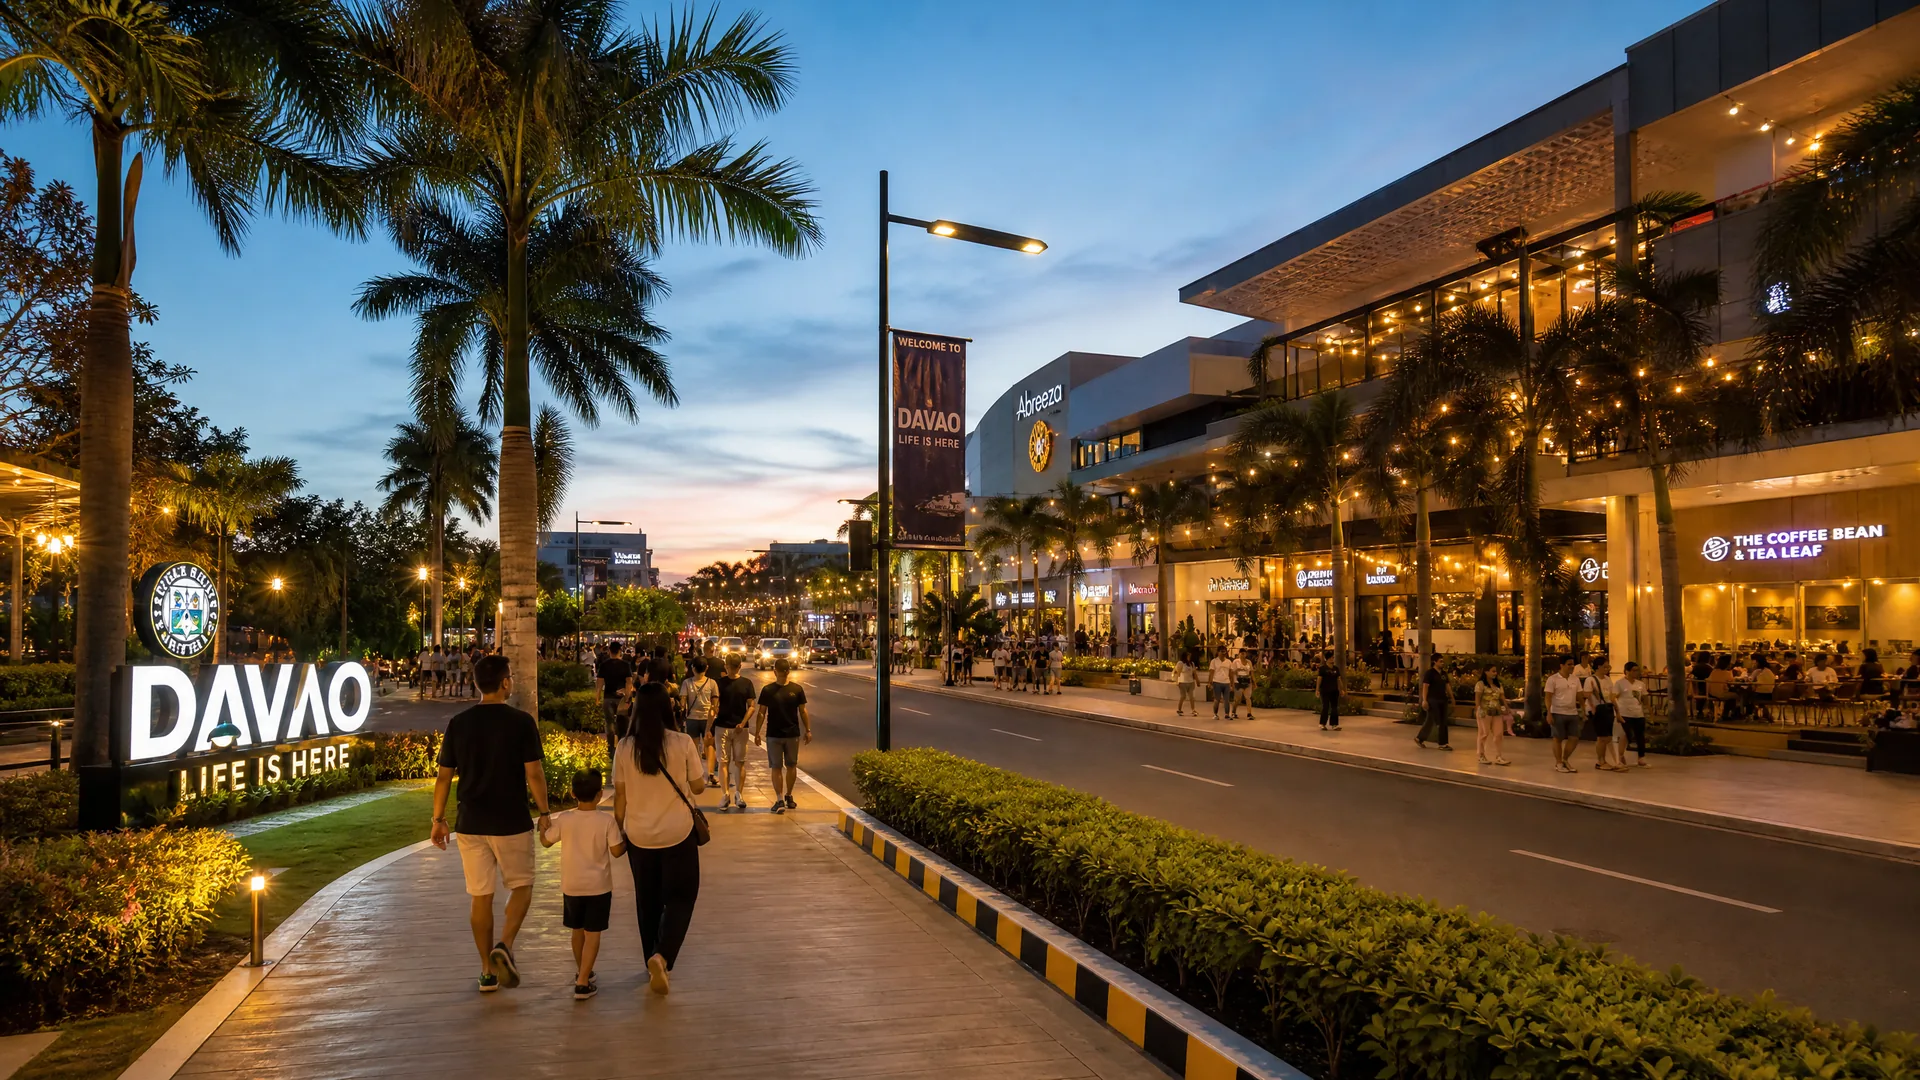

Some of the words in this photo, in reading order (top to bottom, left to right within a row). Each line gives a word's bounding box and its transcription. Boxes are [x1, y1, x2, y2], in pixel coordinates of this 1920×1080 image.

[898, 336, 946, 353] WELCOME
[948, 342, 961, 353] TO
[1016, 384, 1062, 421] Abreeza
[898, 407, 961, 433] DAVAO
[898, 434, 919, 445] LIFE
[922, 436, 931, 446] IS
[934, 437, 960, 449] HERE
[1733, 534, 1763, 547] THE
[1766, 528, 1827, 545] COFFEE
[1832, 524, 1883, 540] BEAN
[1734, 549, 1745, 561] &
[1747, 547, 1774, 560] TEA
[1781, 544, 1822, 558] LEAF
[130, 661, 372, 761] DAVAO
[180, 760, 246, 801] LIFE
[258, 754, 281, 786] IS
[292, 743, 350, 779] HERE
